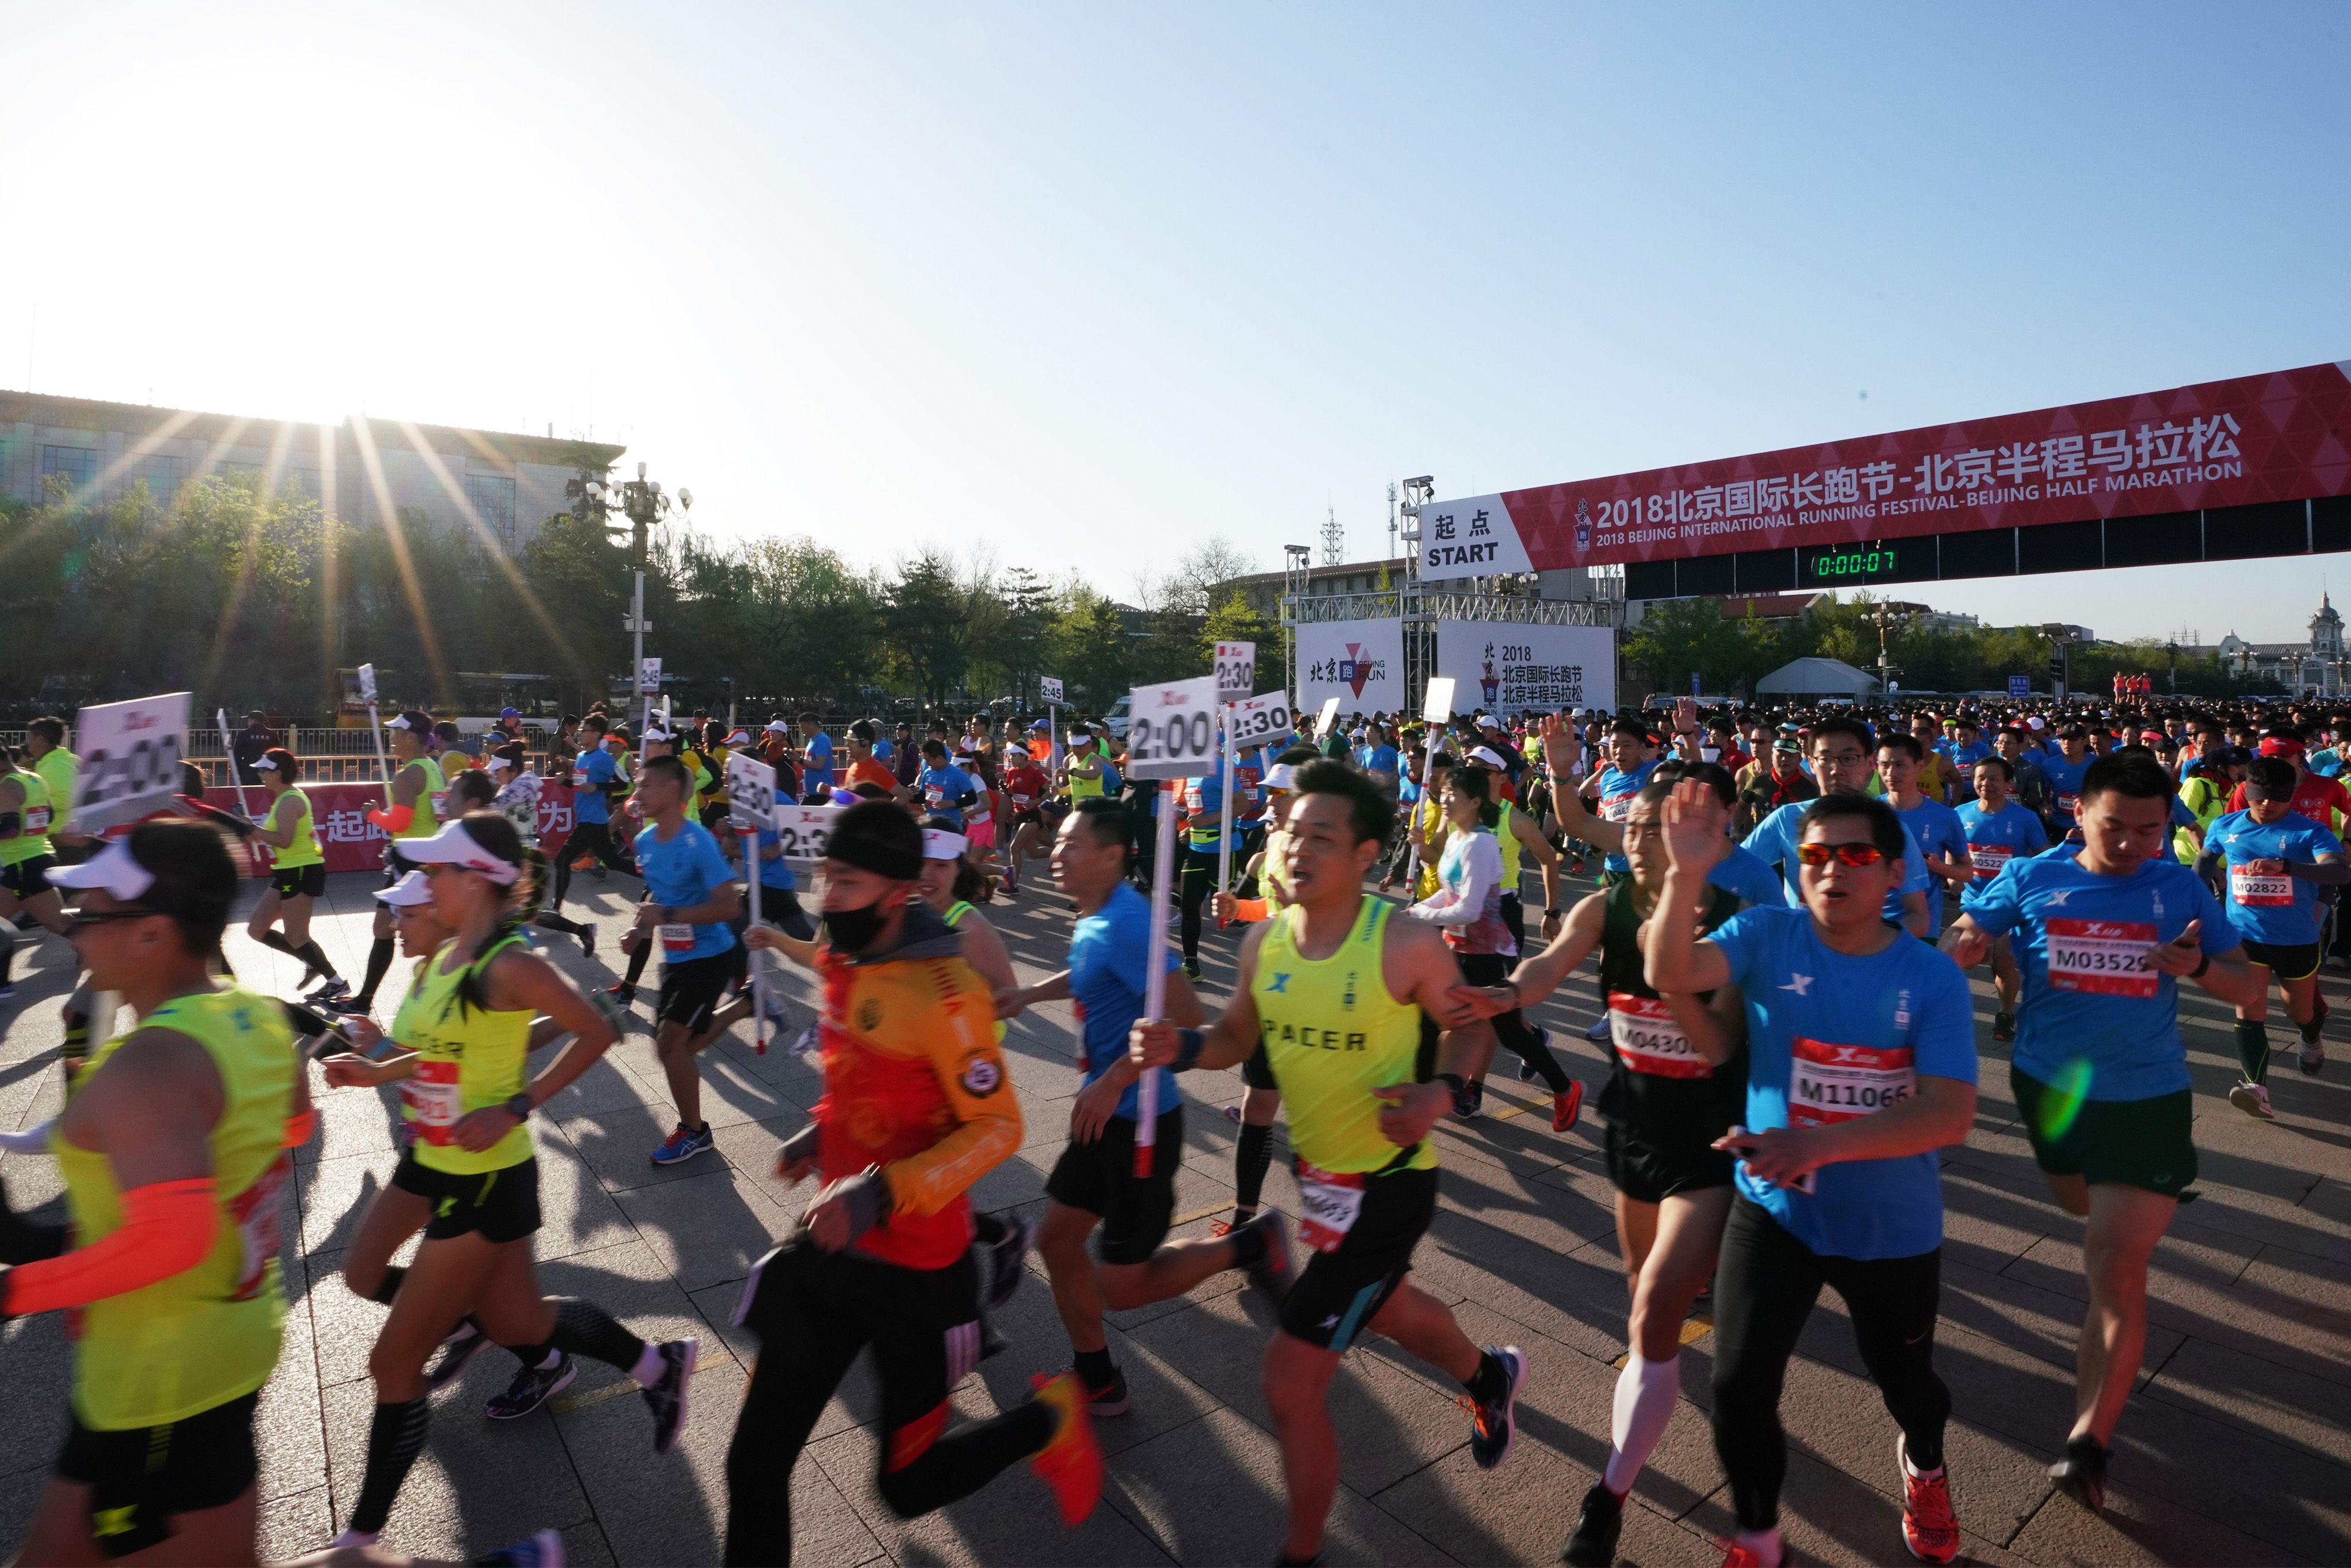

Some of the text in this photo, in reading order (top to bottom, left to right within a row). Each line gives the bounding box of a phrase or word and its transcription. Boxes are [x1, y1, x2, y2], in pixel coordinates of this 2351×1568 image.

[1597, 412, 2241, 528] 2018北京国际长跑节-北京半程马拉松
[1596, 533, 1625, 546] 2018
[1628, 525, 1676, 543] BEIJING
[1680, 512, 1795, 537] INTERNATIONAL
[1799, 503, 1876, 523] RUNNING
[2046, 478, 2098, 498] HALF
[2105, 461, 2242, 491] MARATHON
[1428, 542, 1498, 567] START
[1818, 551, 1894, 575] 0:00:07
[1359, 659, 1385, 668] BEIJING
[1502, 646, 1531, 661] 2018
[1217, 662, 1251, 688] 2:30
[1358, 670, 1385, 681] RUN
[1502, 665, 1582, 684] 北京国际长跑节
[1042, 685, 1061, 699] 2:45
[1502, 685, 1583, 704] 北京半程马拉松
[1134, 711, 1209, 759] 2:00
[781, 827, 830, 857] 2:3
[1972, 859, 2006, 868] M0522
[2235, 883, 2287, 893] M02822
[1262, 1018, 1367, 1051] PACER
[1619, 1026, 1702, 1055] M0430
[1799, 1078, 1908, 1107] M11066
